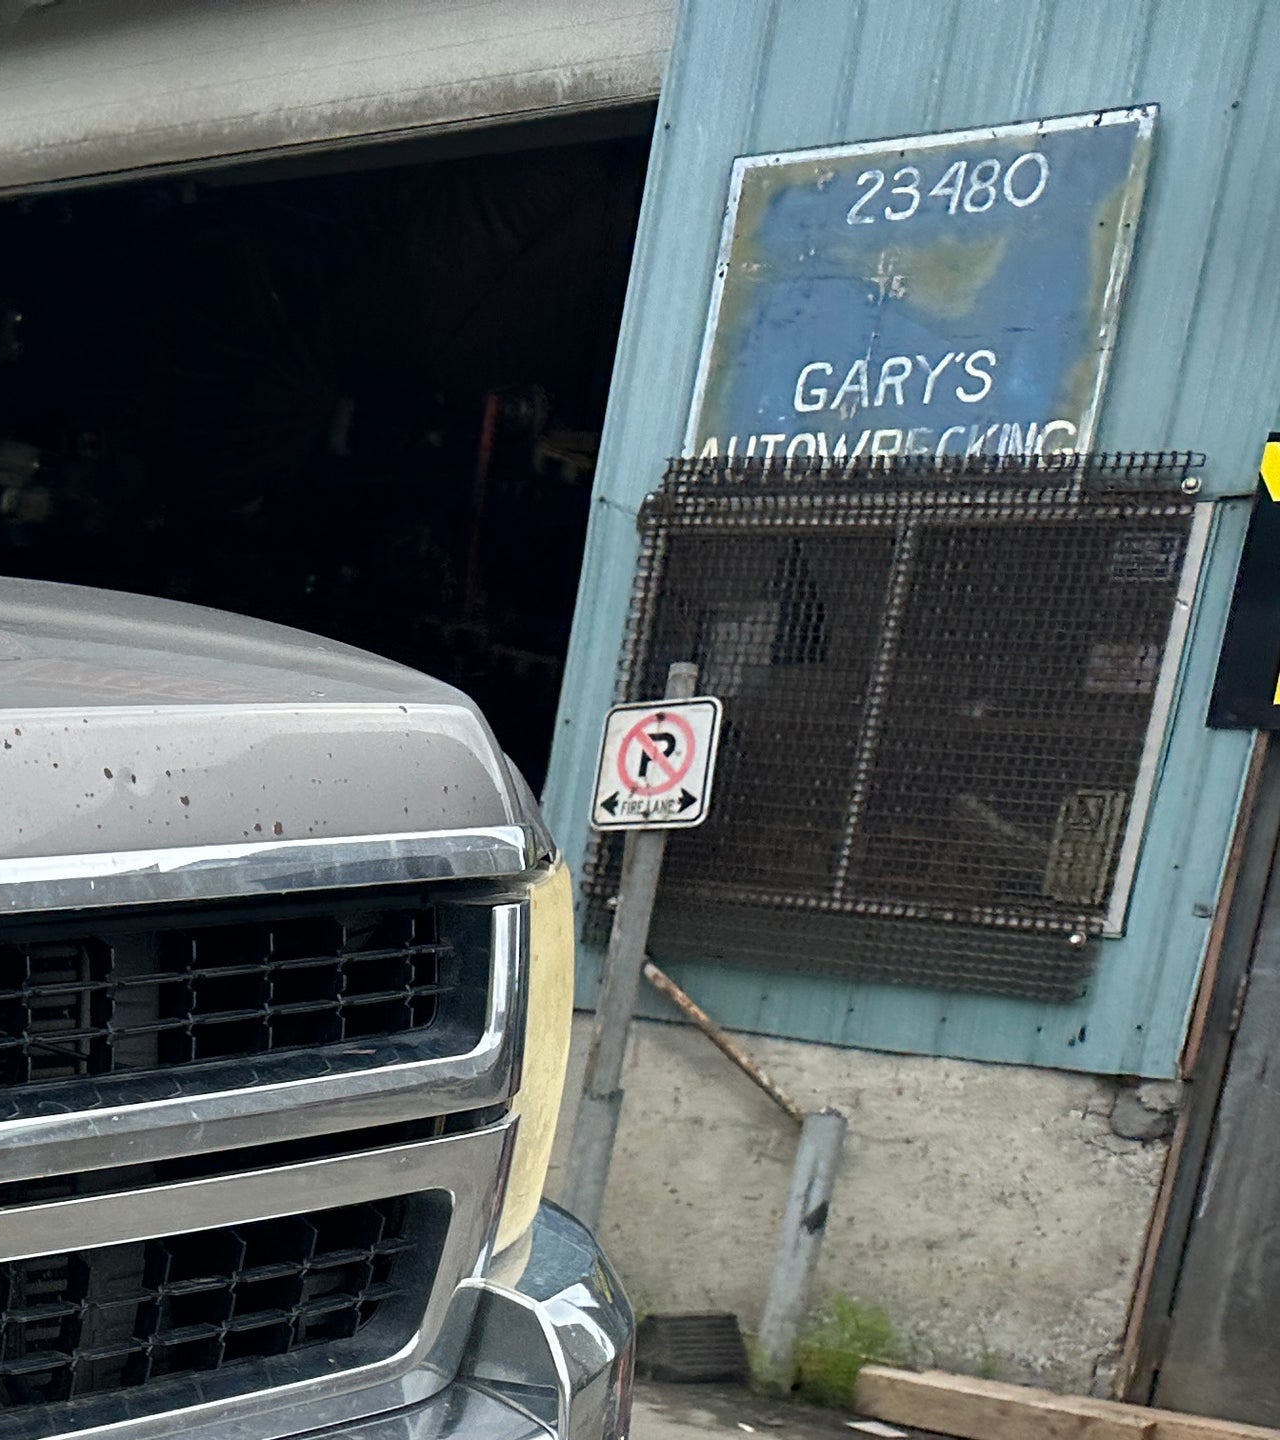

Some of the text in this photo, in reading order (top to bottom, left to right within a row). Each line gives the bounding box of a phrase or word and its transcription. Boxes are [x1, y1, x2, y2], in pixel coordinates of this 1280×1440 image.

[846, 151, 1050, 225] 23480
[794, 348, 998, 413] GARY'S
[621, 797, 676, 815] FIRE LANE
